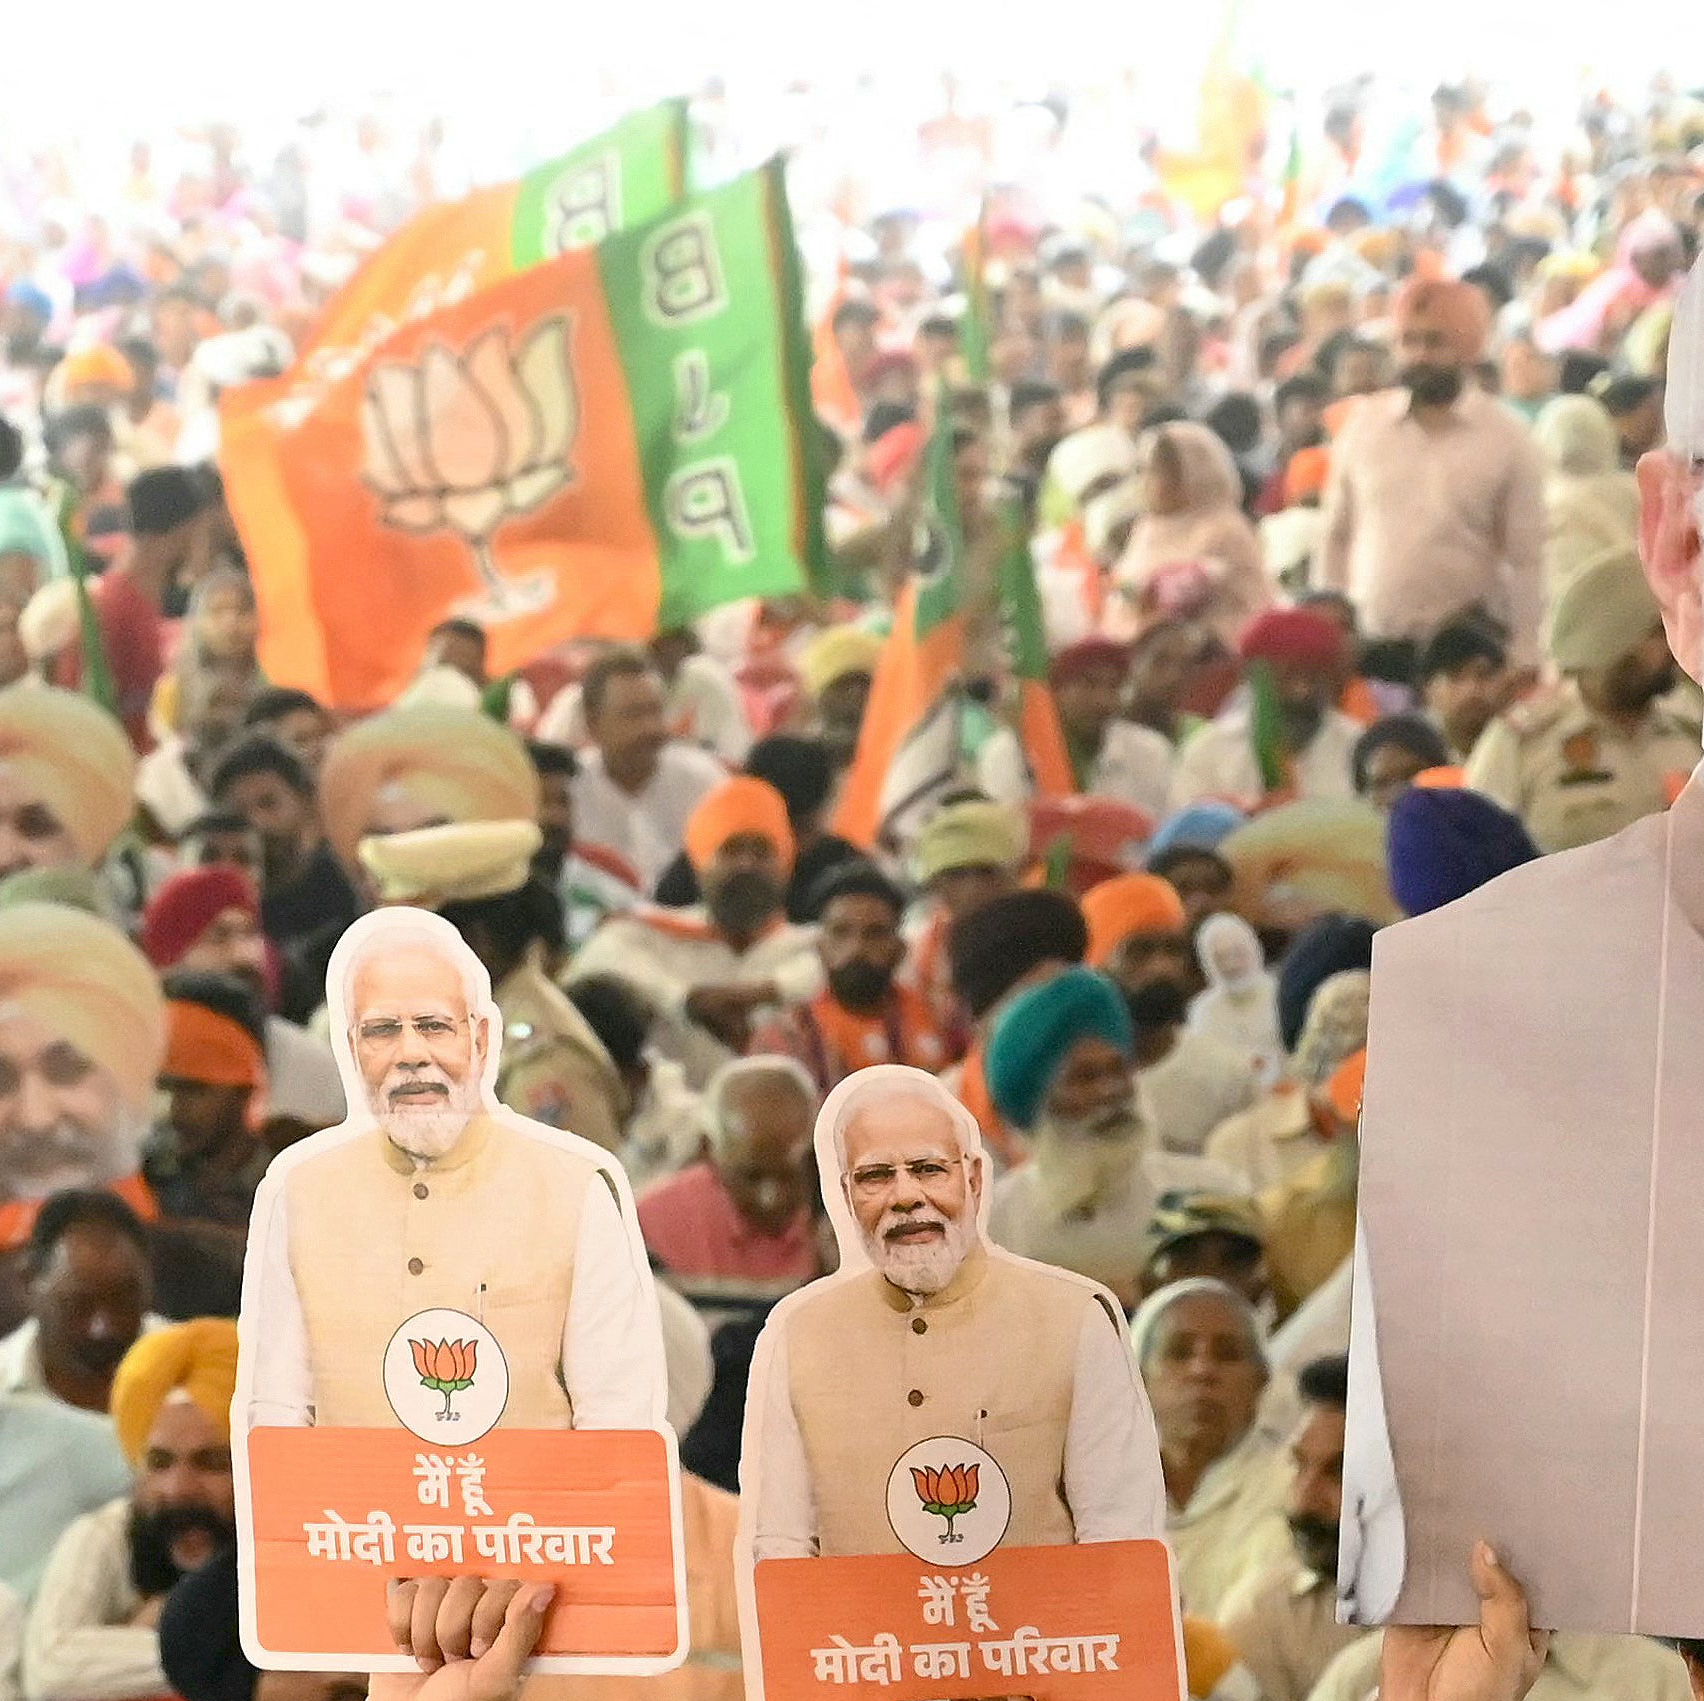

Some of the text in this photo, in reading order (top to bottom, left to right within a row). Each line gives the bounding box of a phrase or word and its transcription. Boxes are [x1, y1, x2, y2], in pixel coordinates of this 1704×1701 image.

[412, 1452, 494, 1516] मैं हूँ
[302, 1509, 616, 1566] मोदी का परिवार
[917, 1572, 999, 1632] मैं हूँ
[810, 1625, 1120, 1685] मोदी का परिवार
